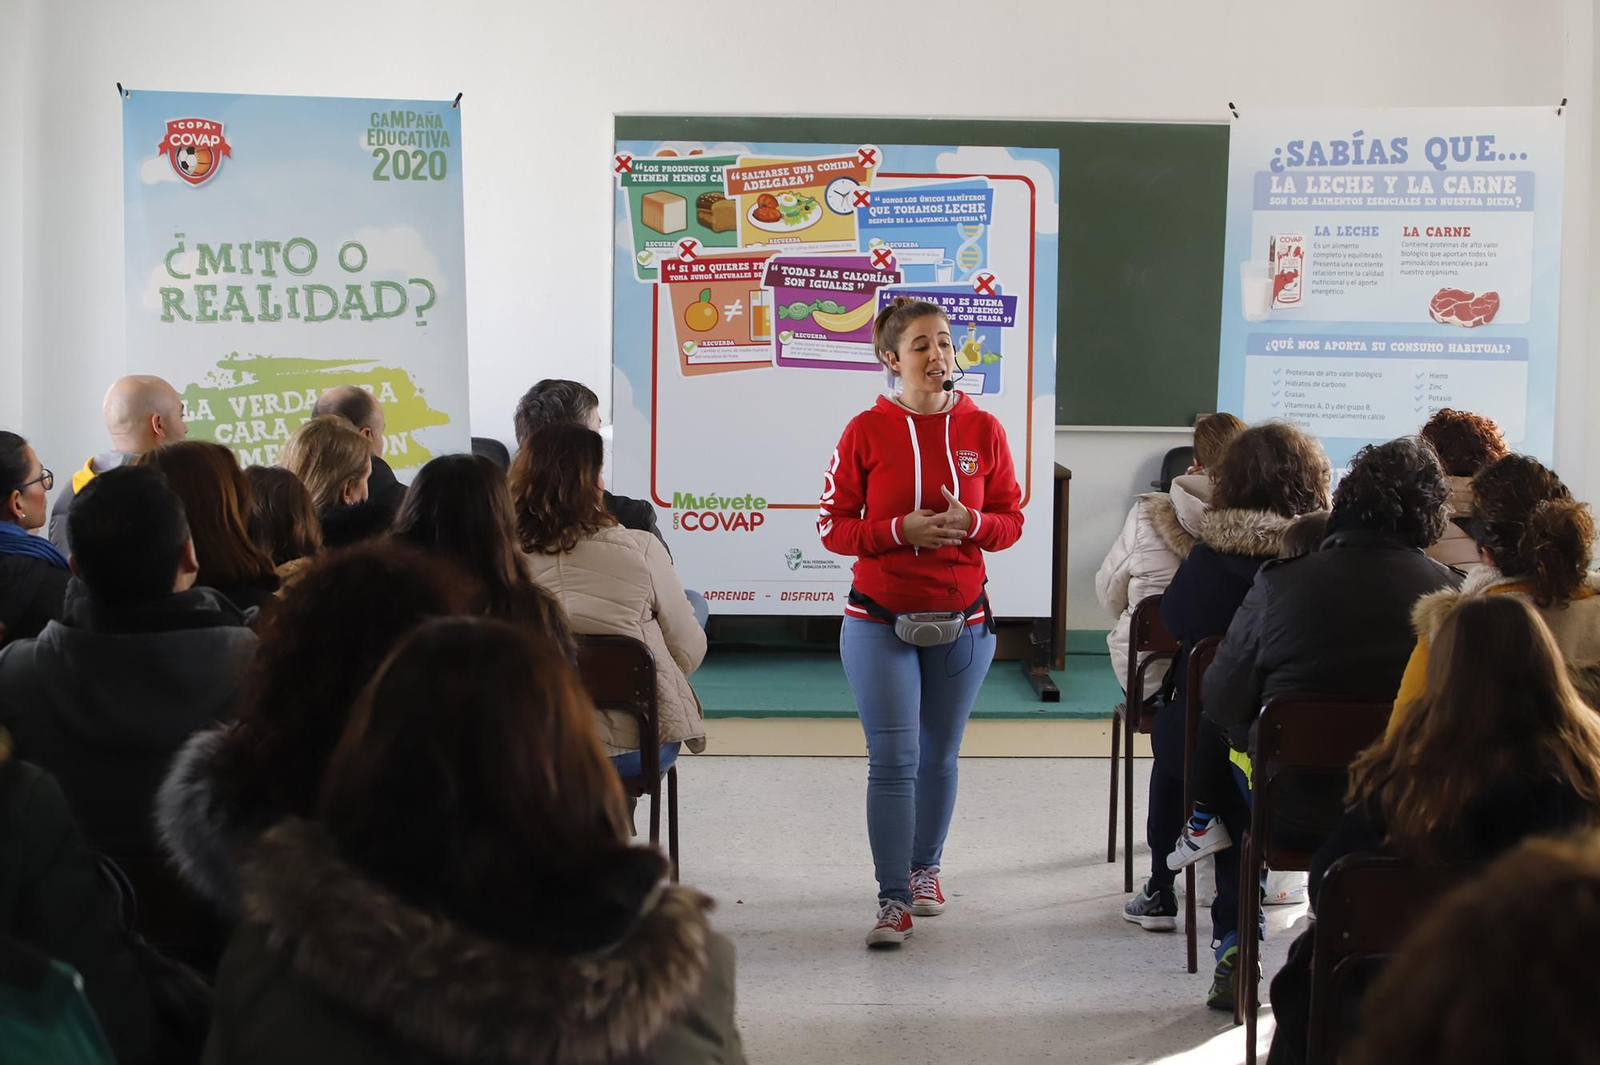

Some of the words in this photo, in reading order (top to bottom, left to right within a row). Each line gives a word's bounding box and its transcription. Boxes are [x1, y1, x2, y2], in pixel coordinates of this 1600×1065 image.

[178, 121, 211, 130] COPA
[370, 110, 444, 128] CAMPAÑA
[170, 132, 220, 147] COVAP
[367, 128, 450, 148] EDUCATIVA
[1270, 130, 1408, 173] ¿SABÍAS
[1425, 135, 1527, 171] QUE...
[372, 147, 447, 181] 2020
[792, 165, 814, 174] UNA
[817, 160, 855, 172] COMIDA
[631, 174, 669, 182] TIENEN
[672, 174, 706, 182] MENOS
[1270, 176, 1297, 193] LA
[1306, 176, 1374, 193] LECHE
[1384, 176, 1398, 193] Y
[1407, 176, 1434, 194] LA
[1444, 176, 1516, 194] CARNE
[1270, 197, 1287, 205] SON
[1291, 197, 1308, 205] DOS
[1312, 197, 1363, 205] ALIMENTOS
[1367, 197, 1421, 205] ESENCIALES
[1486, 196, 1522, 208] DIETA?
[869, 206, 890, 216] QUE
[894, 204, 942, 214] TOMAMOS
[945, 203, 985, 214] LECHE
[1314, 226, 1330, 236] LA
[1337, 226, 1379, 237] LECHE
[1403, 227, 1419, 237] LA
[1426, 227, 1471, 237] CARNE
[164, 232, 318, 280] ¿MITO
[338, 240, 368, 274] O
[709, 263, 749, 273] QUIERES
[784, 277, 805, 287] SON
[820, 269, 839, 278] LAS
[843, 272, 894, 283] CALORÍAS
[159, 278, 436, 326] REALIDAD?
[973, 298, 1004, 307] BUENA
[1265, 338, 1294, 351] ¿QUÉ
[1298, 340, 1320, 350] NOS
[1324, 341, 1367, 351] APORTA
[1372, 342, 1386, 351] SU
[1390, 342, 1444, 352] CONSUMO
[1448, 343, 1511, 354] HABITUAL?
[1355, 371, 1382, 379] biológico
[182, 399, 216, 422] LA
[214, 418, 292, 444] CARA
[673, 492, 766, 510] Muévete
[681, 511, 764, 531] COVAP
[704, 591, 756, 601] APRENDE
[780, 592, 834, 601] DISFRUTA
